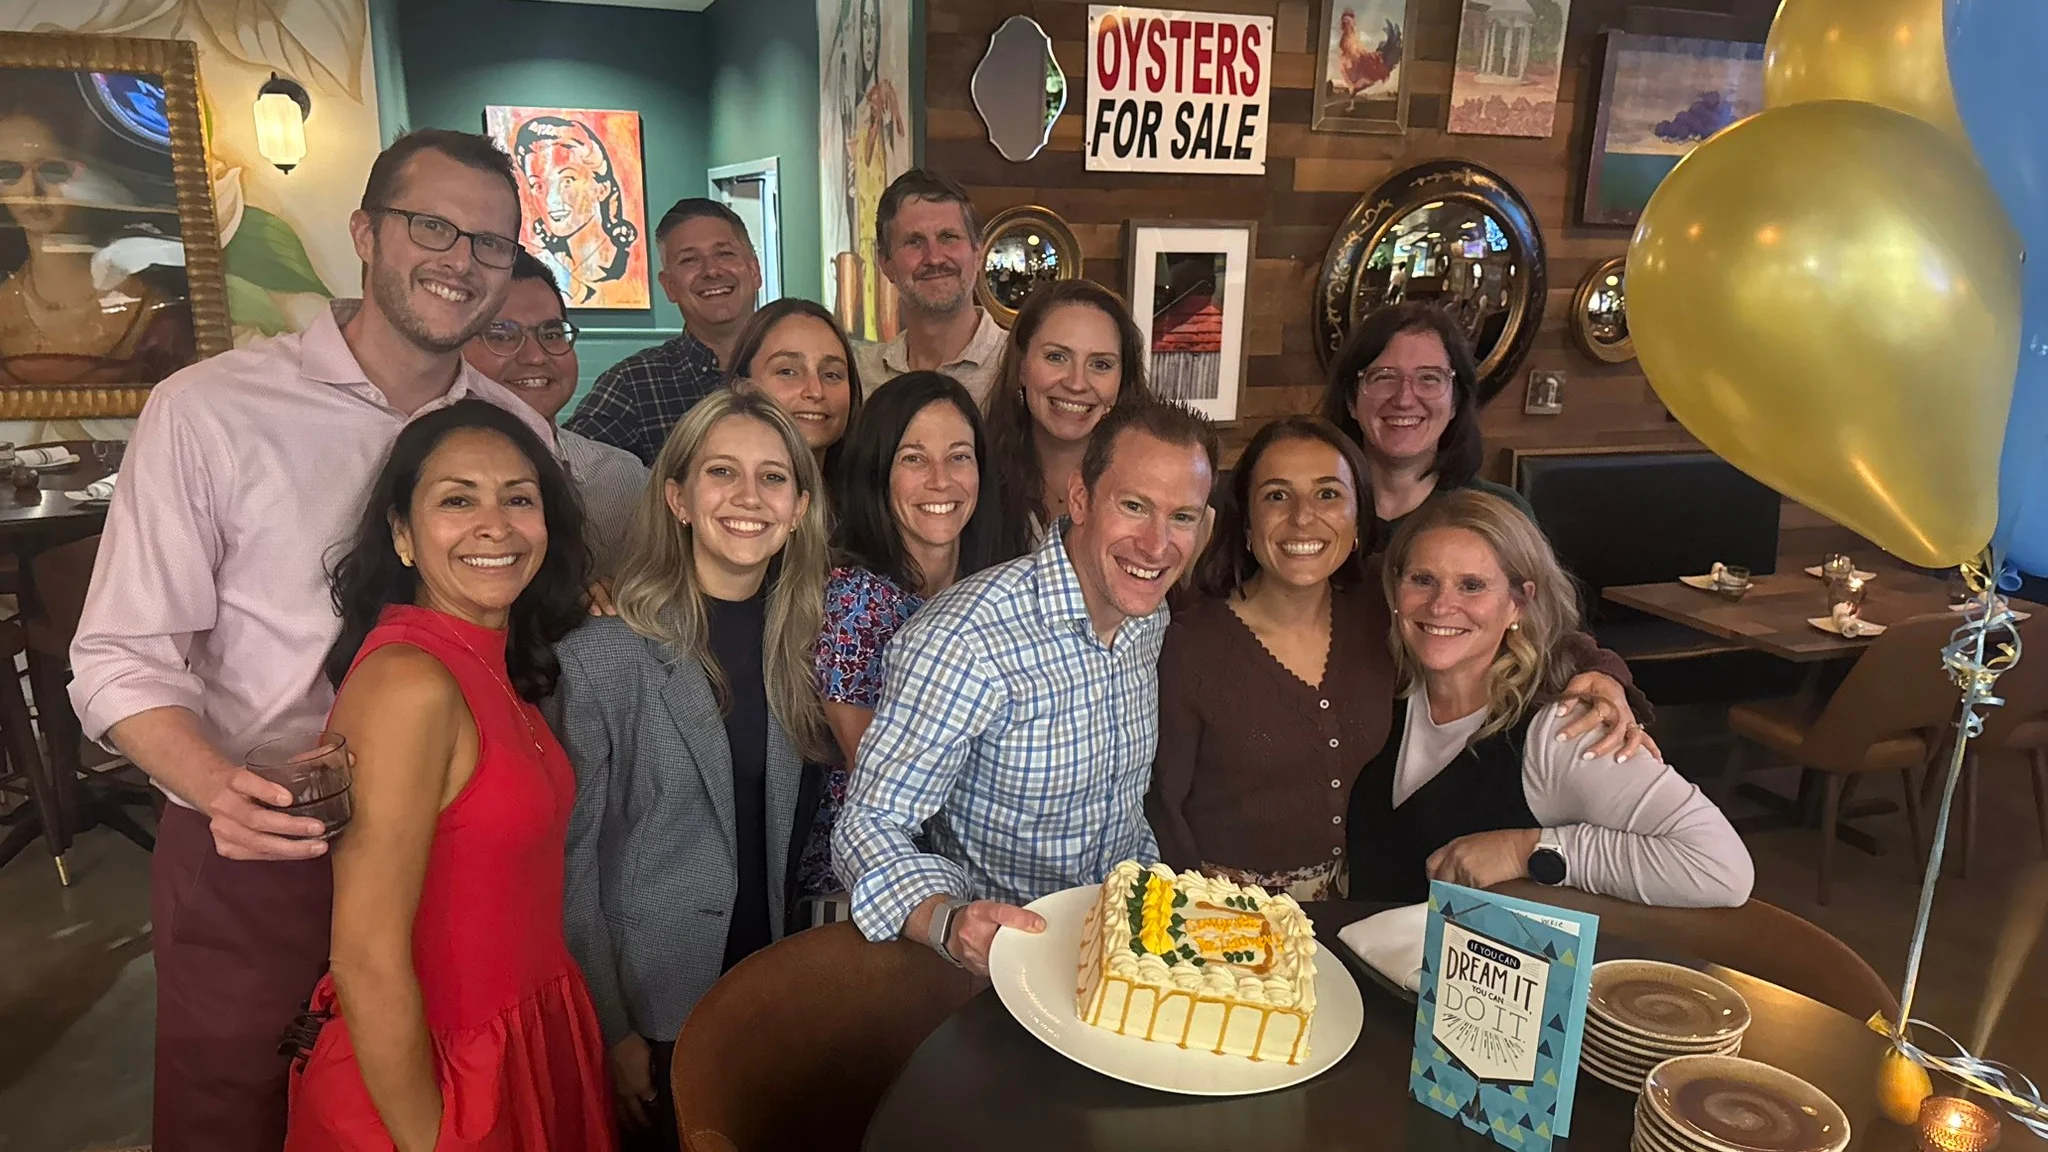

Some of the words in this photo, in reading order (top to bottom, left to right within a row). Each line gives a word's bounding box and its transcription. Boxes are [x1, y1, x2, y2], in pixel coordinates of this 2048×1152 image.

[1096, 14, 1261, 97] OYSTERS
[1091, 98, 1163, 158] FOR
[1170, 101, 1260, 160] SALE
[1446, 946, 1508, 995] DREAM
[1470, 942, 1479, 952] IF
[1480, 946, 1498, 960] YOU
[1498, 953, 1518, 968] CAN
[1444, 983, 1486, 1021] DO
[1471, 984, 1487, 998] YOU
[1488, 993, 1504, 1005] CAN
